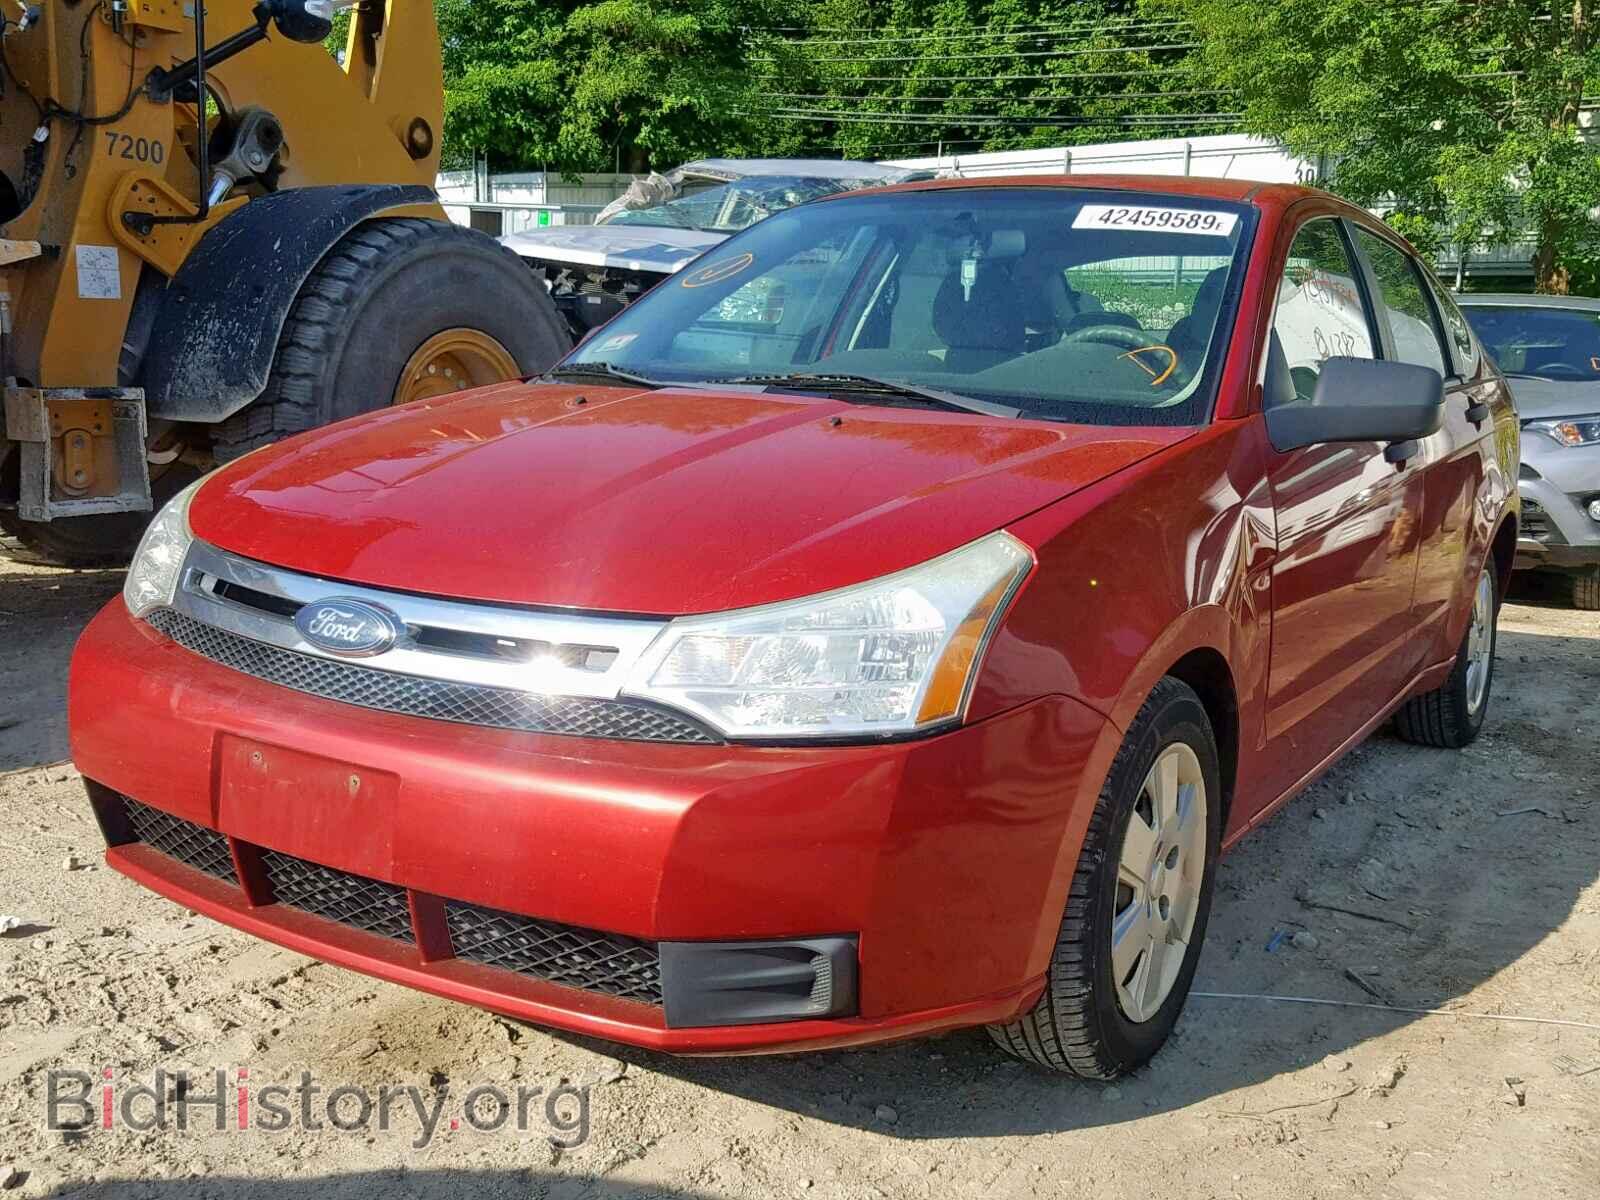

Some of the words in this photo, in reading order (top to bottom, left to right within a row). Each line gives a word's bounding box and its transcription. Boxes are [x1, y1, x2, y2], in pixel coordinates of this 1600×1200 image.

[105, 131, 163, 164] 7200
[1098, 208, 1217, 231] 42459589
[308, 607, 366, 642] Ford
